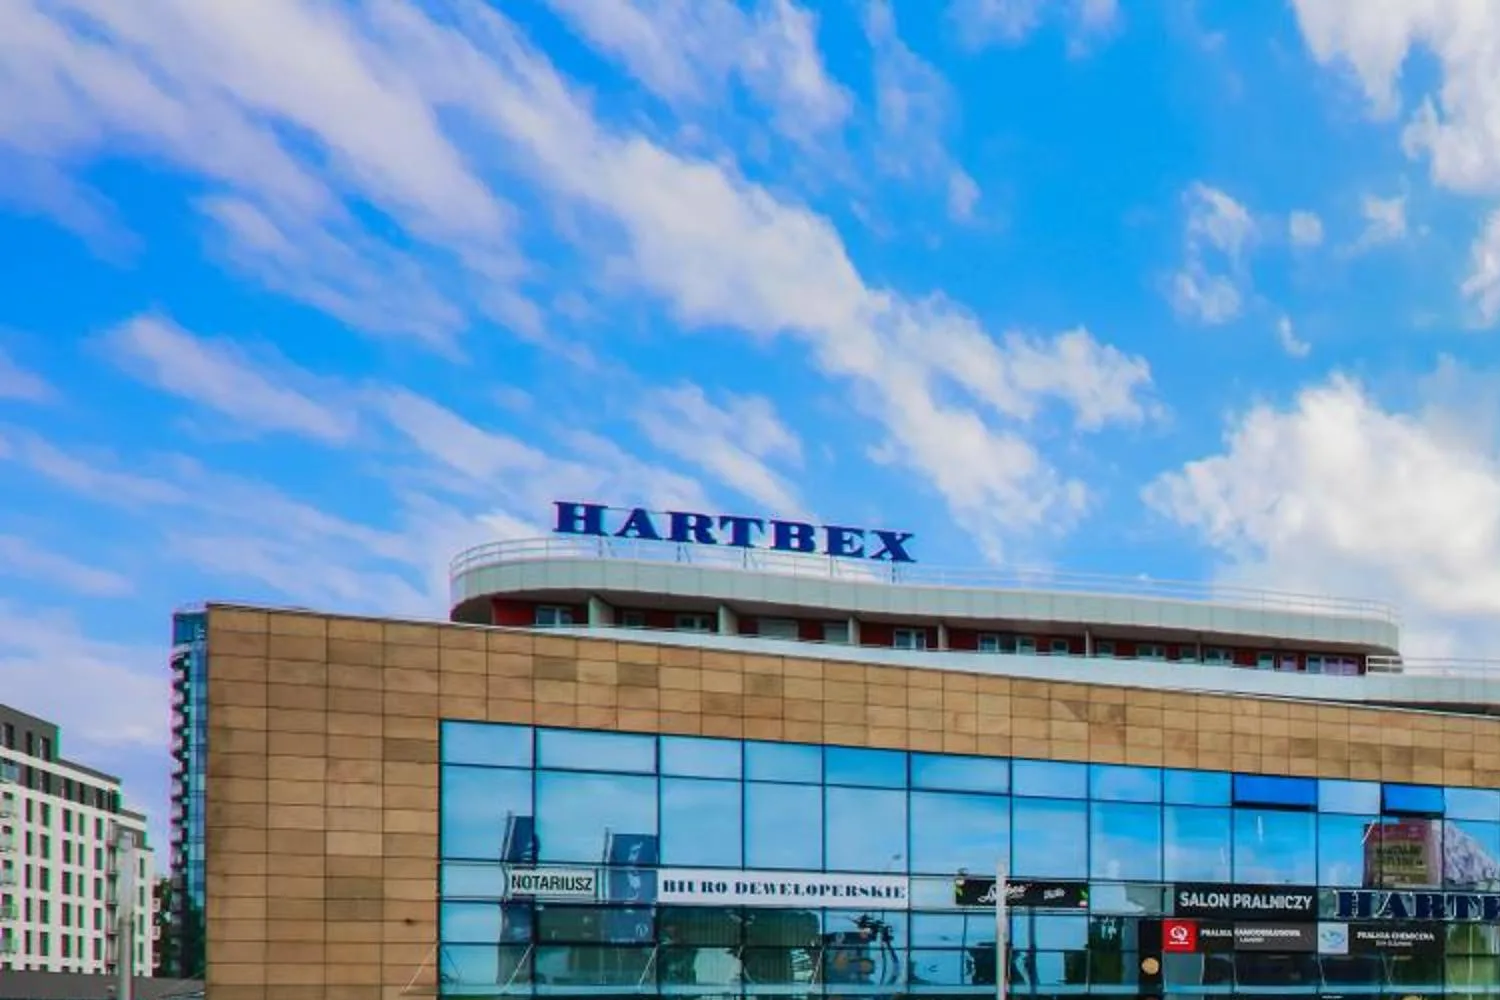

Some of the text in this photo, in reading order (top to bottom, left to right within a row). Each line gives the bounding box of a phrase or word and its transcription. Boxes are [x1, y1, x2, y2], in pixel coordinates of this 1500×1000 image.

[552, 501, 917, 563] HARTBEX
[511, 875, 593, 891] NOTARIUSZ
[663, 879, 906, 899] BIURO DEWELOPERSKIE
[1180, 892, 1313, 910] SALON PRALNICZY
